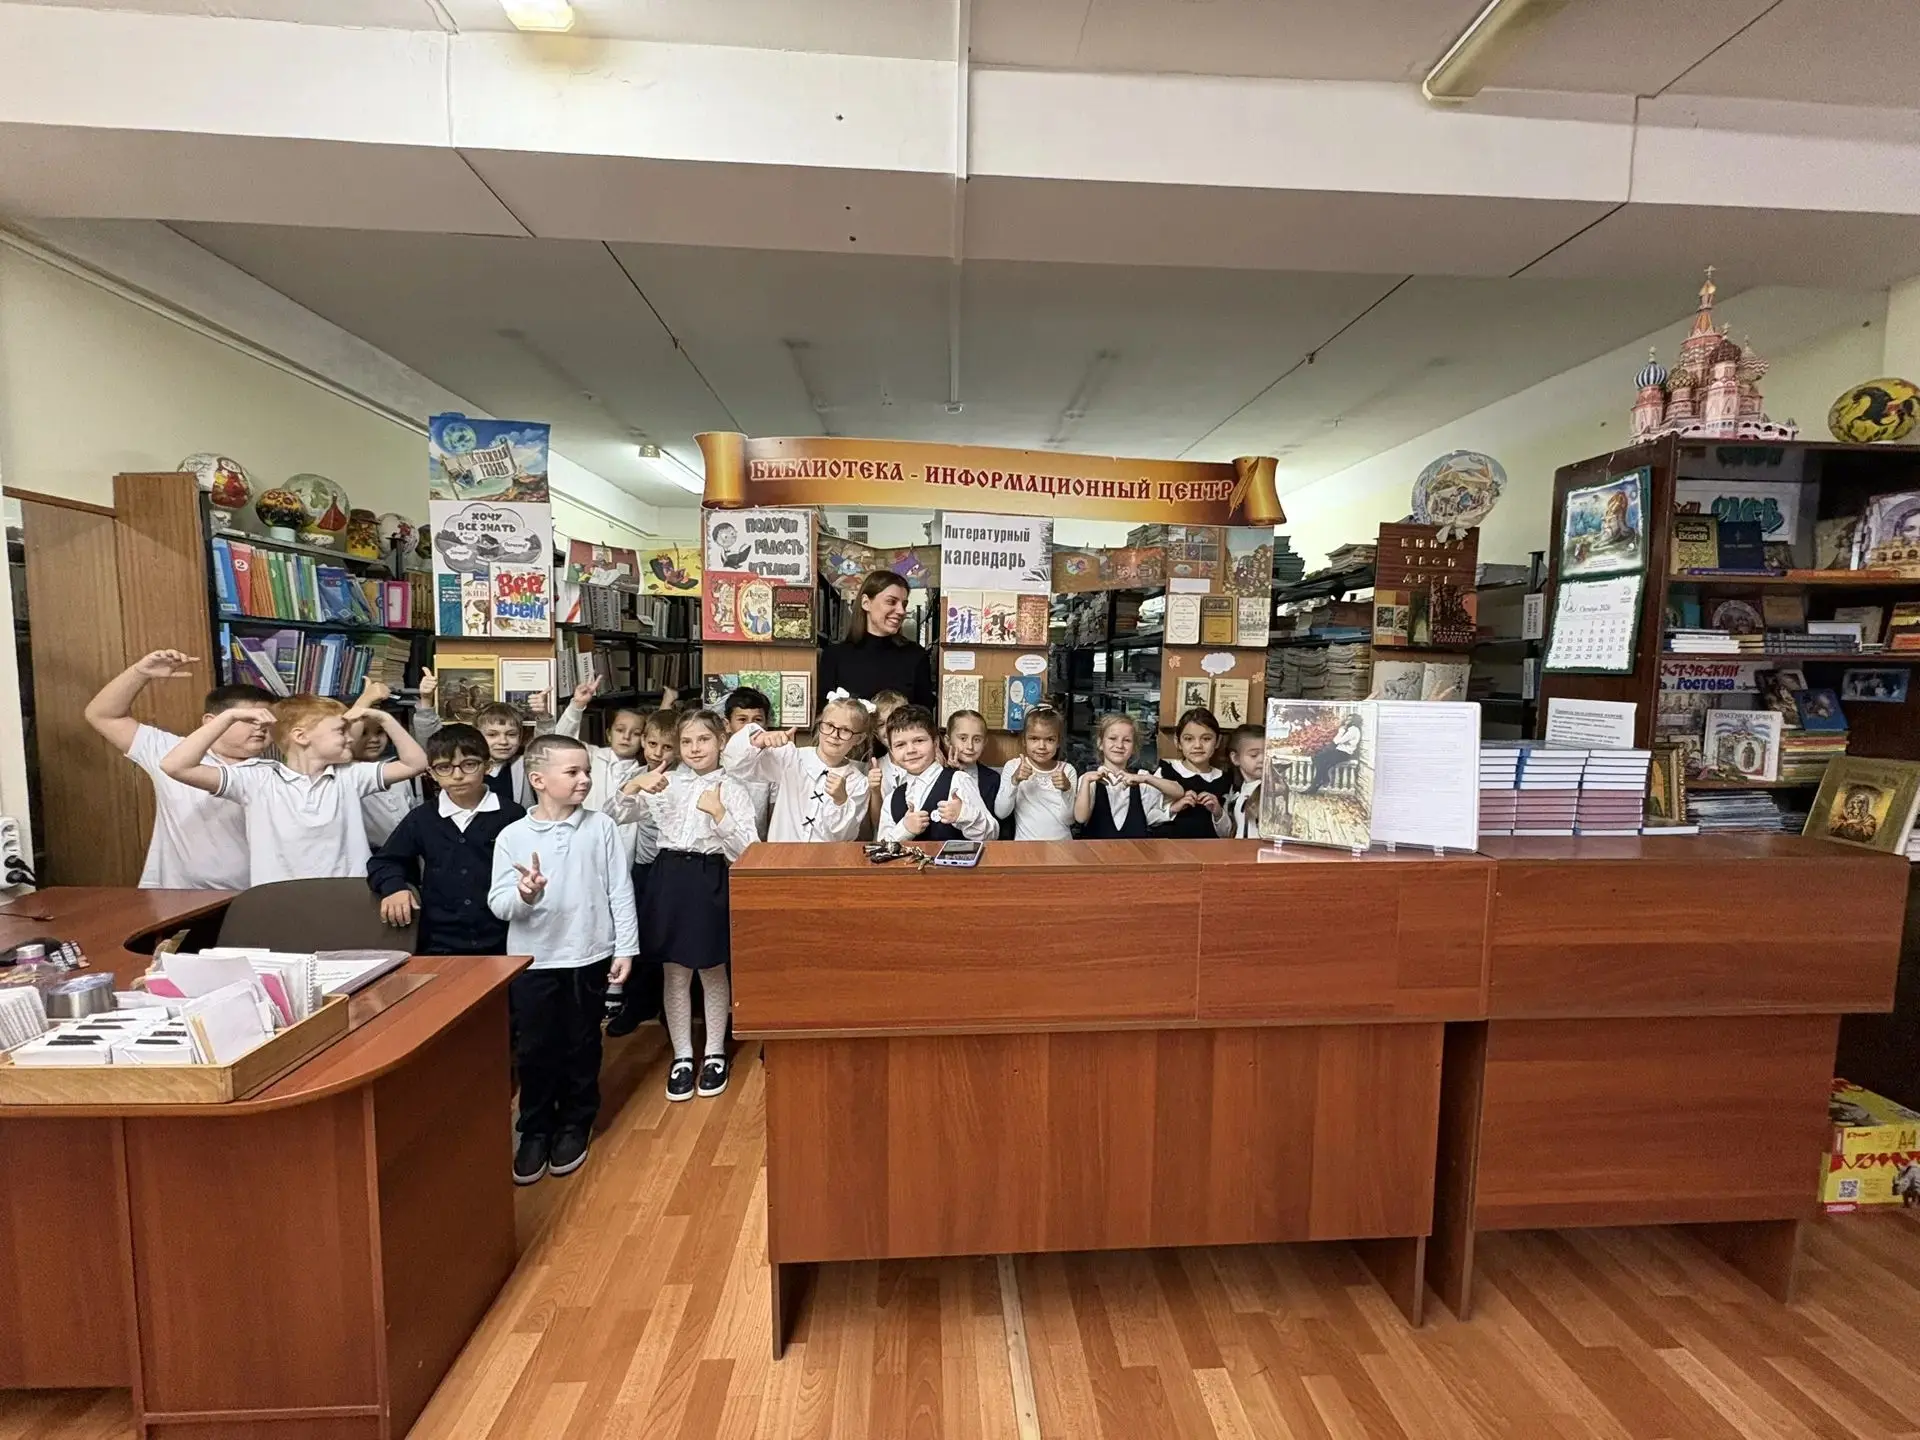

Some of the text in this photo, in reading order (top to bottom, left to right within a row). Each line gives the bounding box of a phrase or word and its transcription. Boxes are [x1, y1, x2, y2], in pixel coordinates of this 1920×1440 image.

[751, 459, 904, 481] БИБЛИОТЕКА
[924, 465, 1151, 500] ИНФОРМАЦИОННЫЙ
[1157, 480, 1233, 505] ЦЕНТР
[472, 512, 503, 521] ХОЧУ
[458, 522, 516, 533] ВСЕ ЗНАТЬ
[745, 517, 799, 534] ПОЛУЧИ
[944, 524, 1031, 543] Литературный
[754, 538, 805, 556] РАДОСТЬ
[236, 561, 245, 569] 2
[944, 549, 1027, 570] календарь
[748, 561, 801, 577] ЧТЕНИЯ
